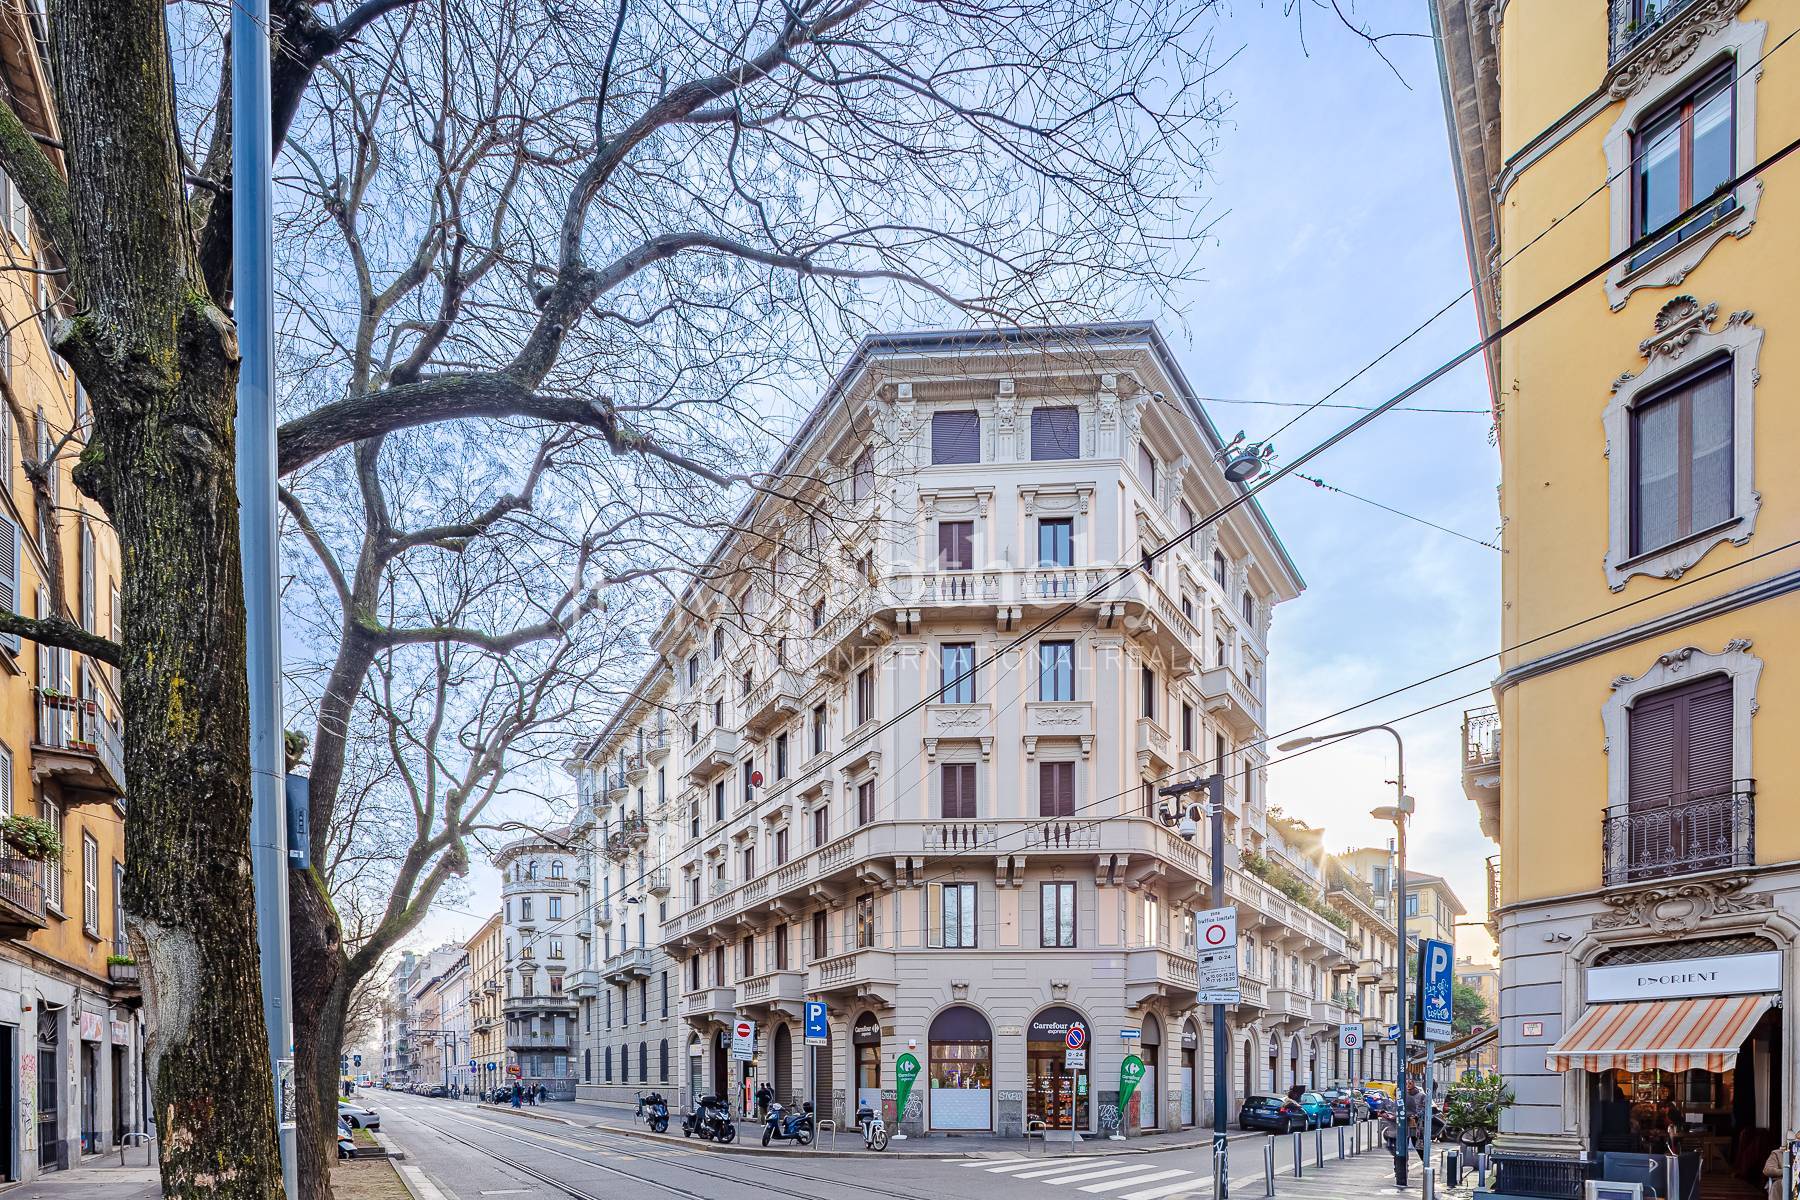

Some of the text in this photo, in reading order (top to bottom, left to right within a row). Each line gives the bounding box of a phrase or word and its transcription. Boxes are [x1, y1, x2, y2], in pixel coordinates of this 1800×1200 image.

[1431, 947, 1447, 984] P
[810, 1004, 822, 1021] P
[1033, 1021, 1068, 1030] Carrefour
